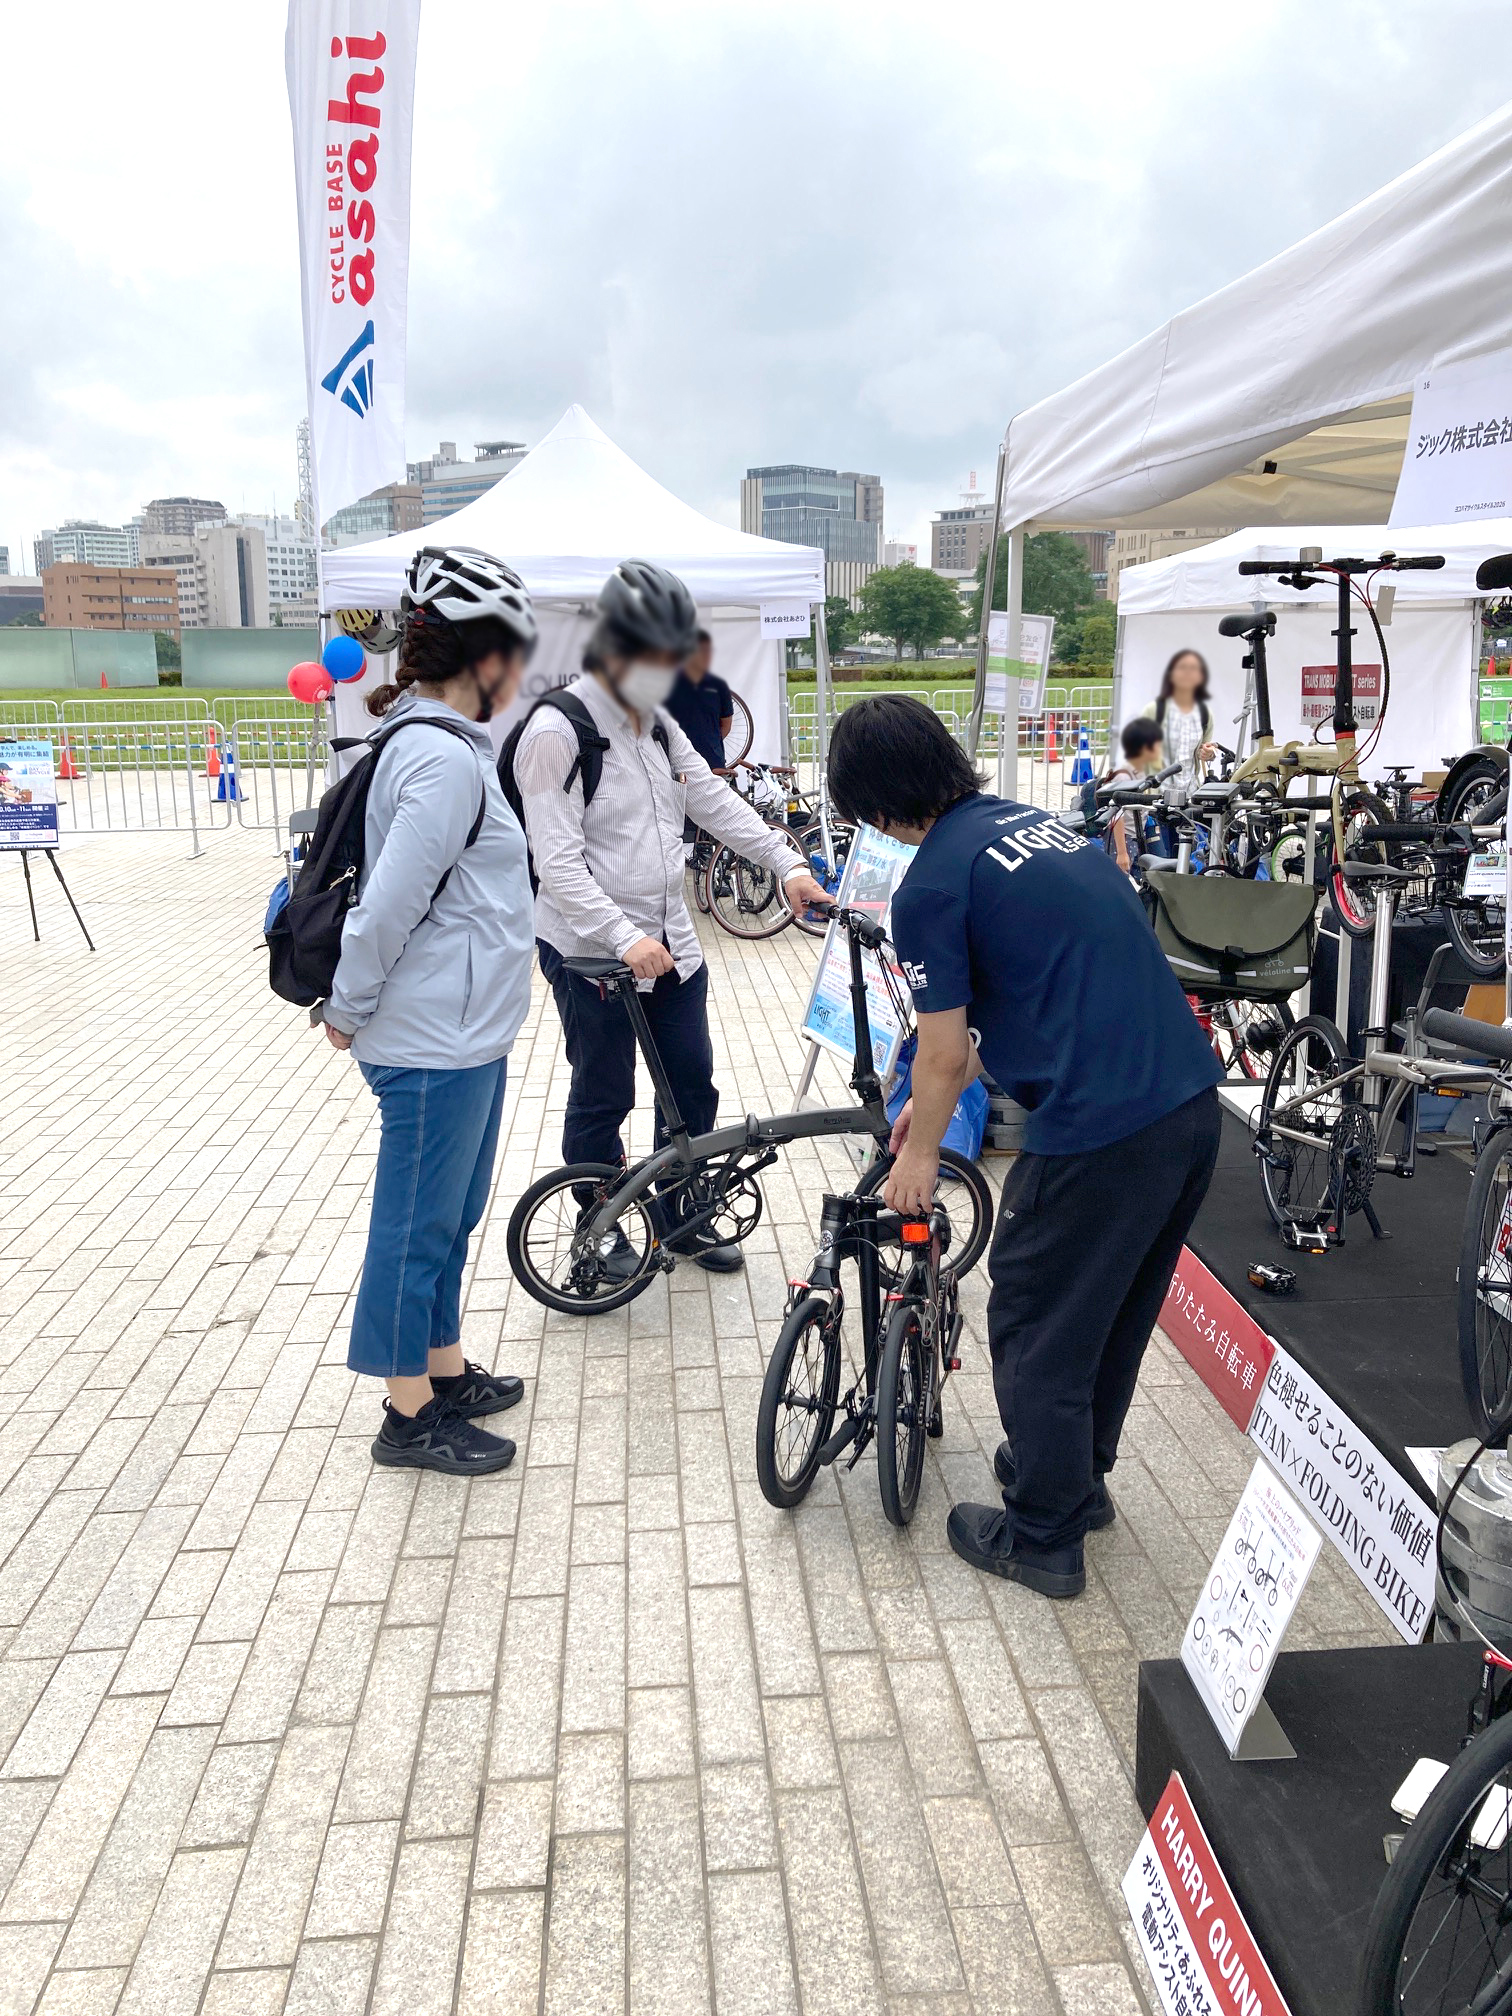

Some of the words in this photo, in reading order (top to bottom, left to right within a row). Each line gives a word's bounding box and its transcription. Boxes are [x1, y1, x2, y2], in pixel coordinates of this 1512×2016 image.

[326, 143, 343, 211] BASE
[328, 30, 387, 307] asahi
[330, 224, 346, 304] CYCLE
[1423, 381, 1430, 390] 16
[764, 615, 805, 623] 株式会社あさひ
[1357, 674, 1376, 689] series
[985, 818, 1077, 872] LIGHT
[1260, 969, 1291, 977] véloline
[1373, 1552, 1427, 1636] BIKE
[1160, 1804, 1214, 1919] HARRY
